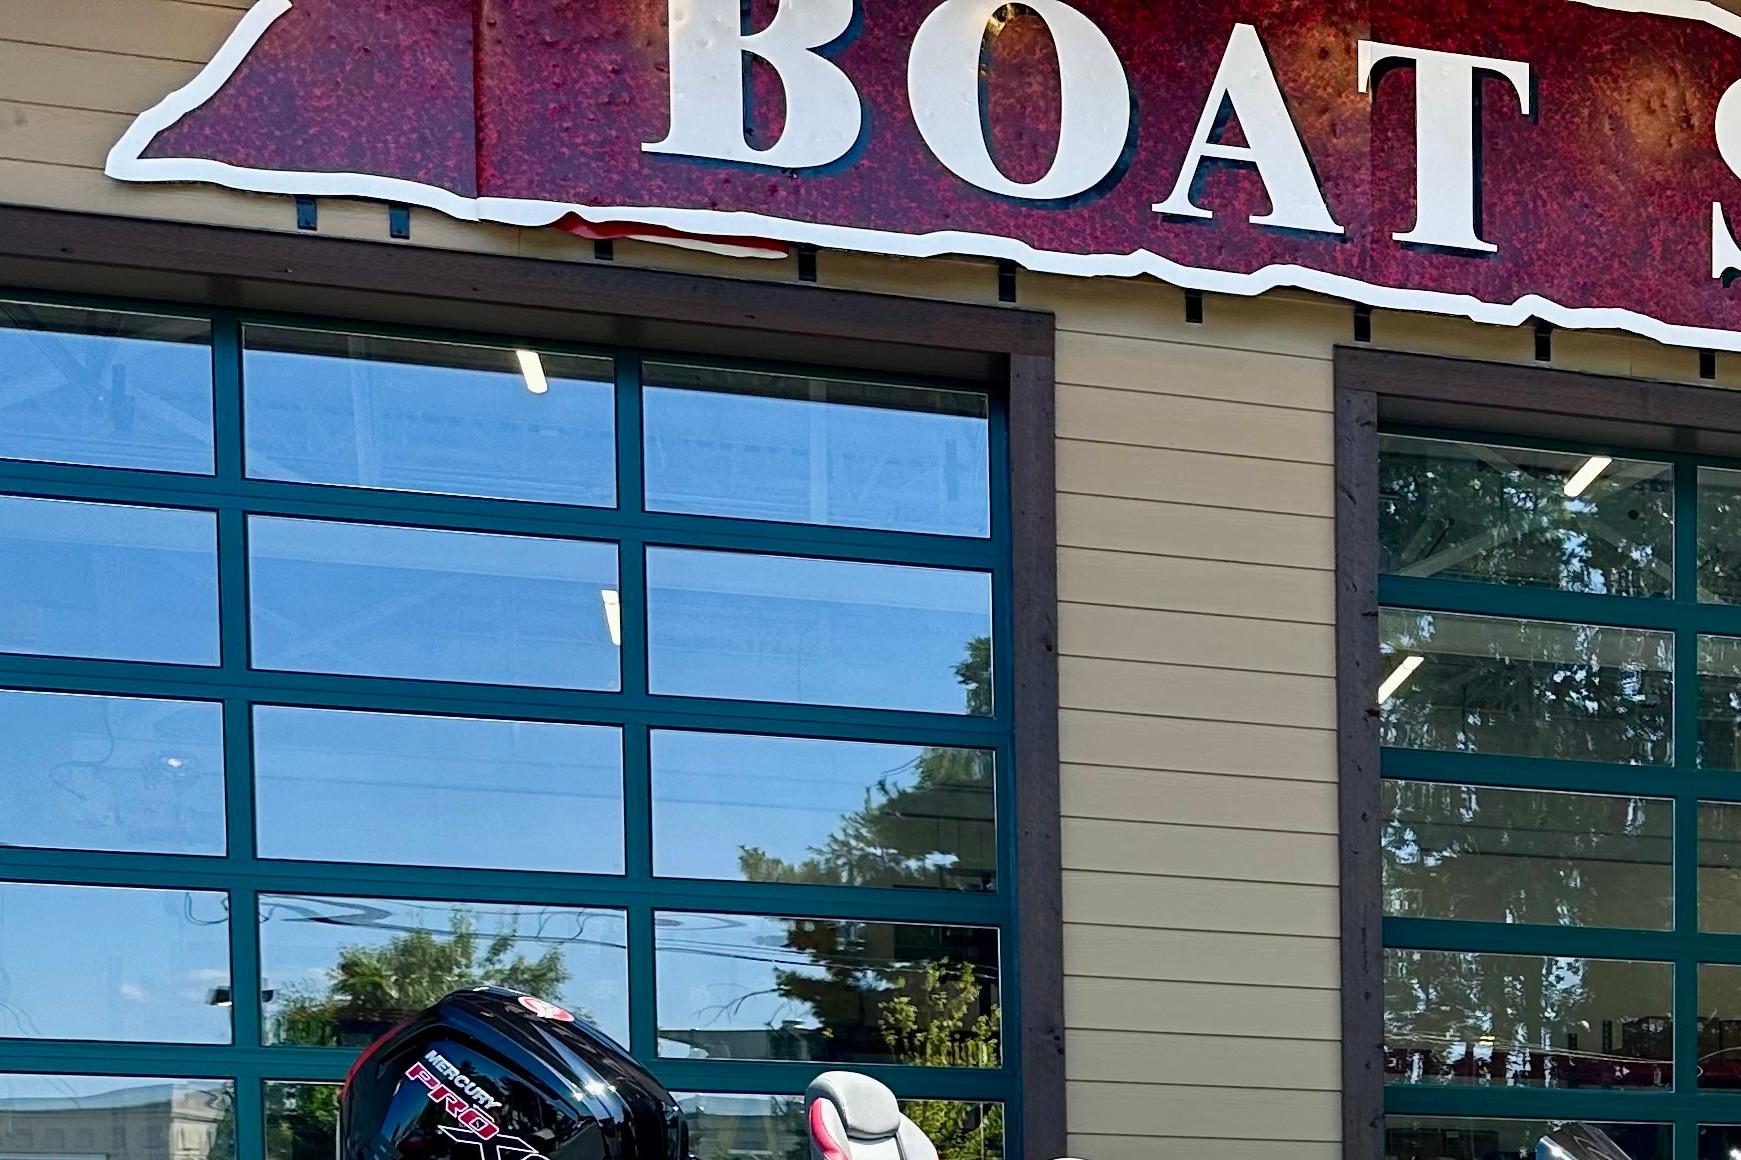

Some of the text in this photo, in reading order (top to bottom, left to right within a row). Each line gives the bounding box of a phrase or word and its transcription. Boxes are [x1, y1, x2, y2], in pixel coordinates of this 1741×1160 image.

[640, 0, 1537, 256] BOAT
[405, 1061, 500, 1141] PRO
[424, 1049, 503, 1110] MERCURY
